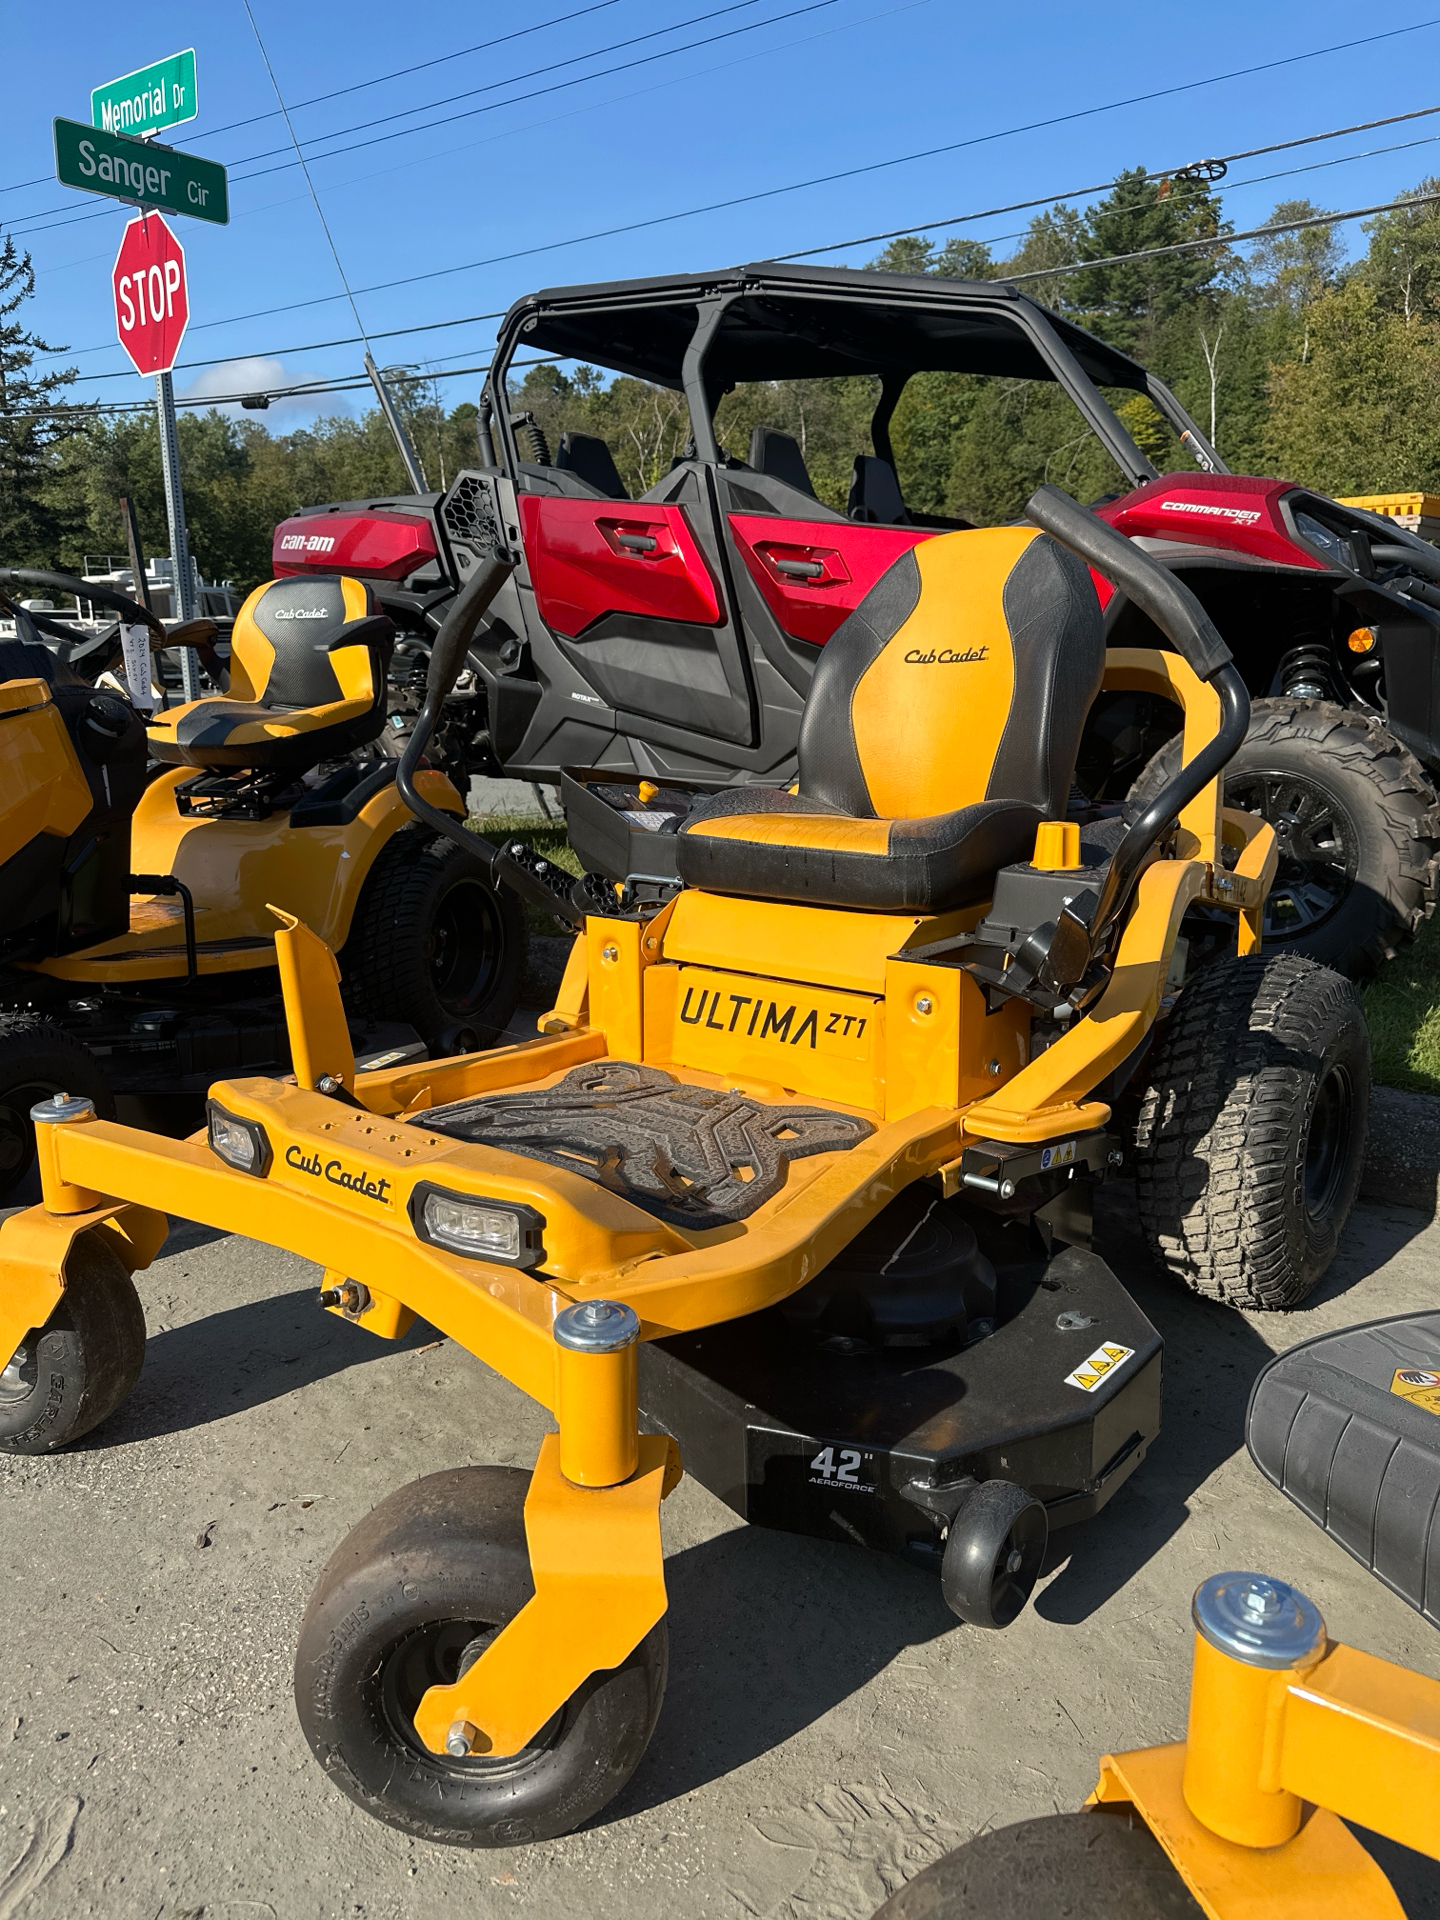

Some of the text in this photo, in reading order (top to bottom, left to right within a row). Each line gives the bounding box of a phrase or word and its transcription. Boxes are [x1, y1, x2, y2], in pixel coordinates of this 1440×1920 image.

[101, 77, 186, 132] Memorial Dr
[79, 140, 209, 206] Sanger Cir
[119, 259, 181, 331] STOP
[1161, 501, 1261, 520] COMMANDER
[1231, 517, 1257, 526] XT
[280, 535, 335, 552] can-am
[275, 607, 329, 619] Cub Cadet
[137, 637, 146, 659] 2024
[904, 645, 990, 664] Cub Cadet
[571, 691, 592, 703] ROTAX
[680, 986, 867, 1050] ULTIMA ZT1
[285, 1145, 391, 1205] Cub Cadet
[810, 1446, 874, 1483] 42"
[808, 1477, 876, 1493] AEROFORCE
